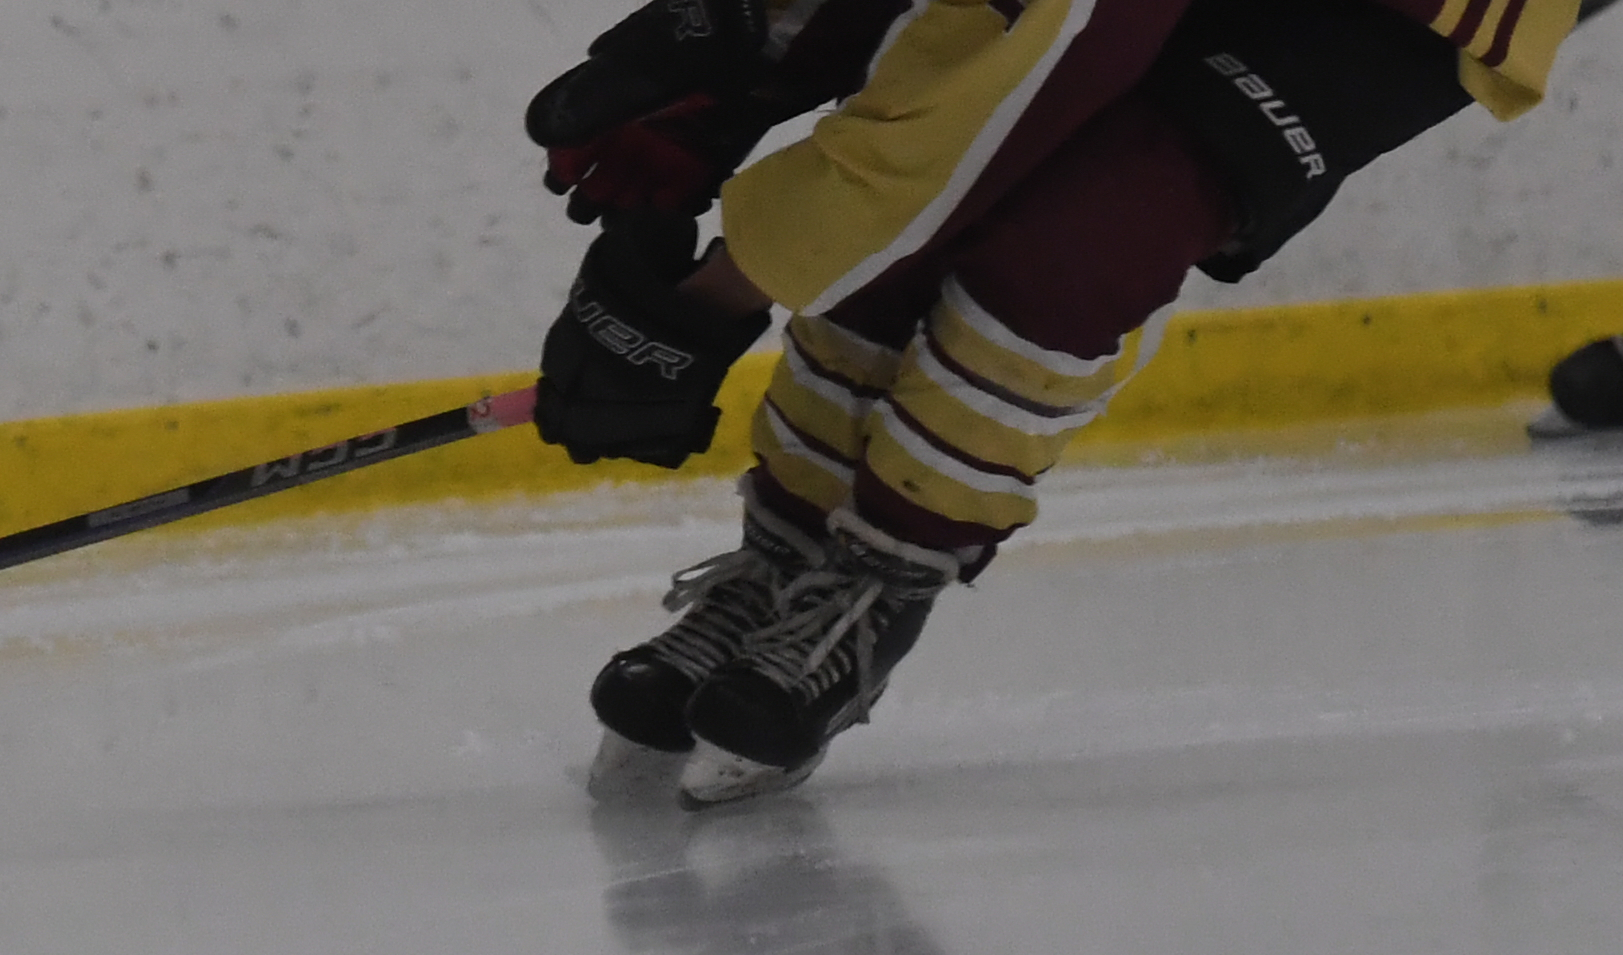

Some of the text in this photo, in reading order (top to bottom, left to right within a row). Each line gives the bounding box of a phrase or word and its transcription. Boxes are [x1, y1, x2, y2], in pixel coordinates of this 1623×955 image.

[1203, 52, 1327, 181] BAUER
[572, 277, 695, 381] UER
[249, 425, 398, 490] CCM
